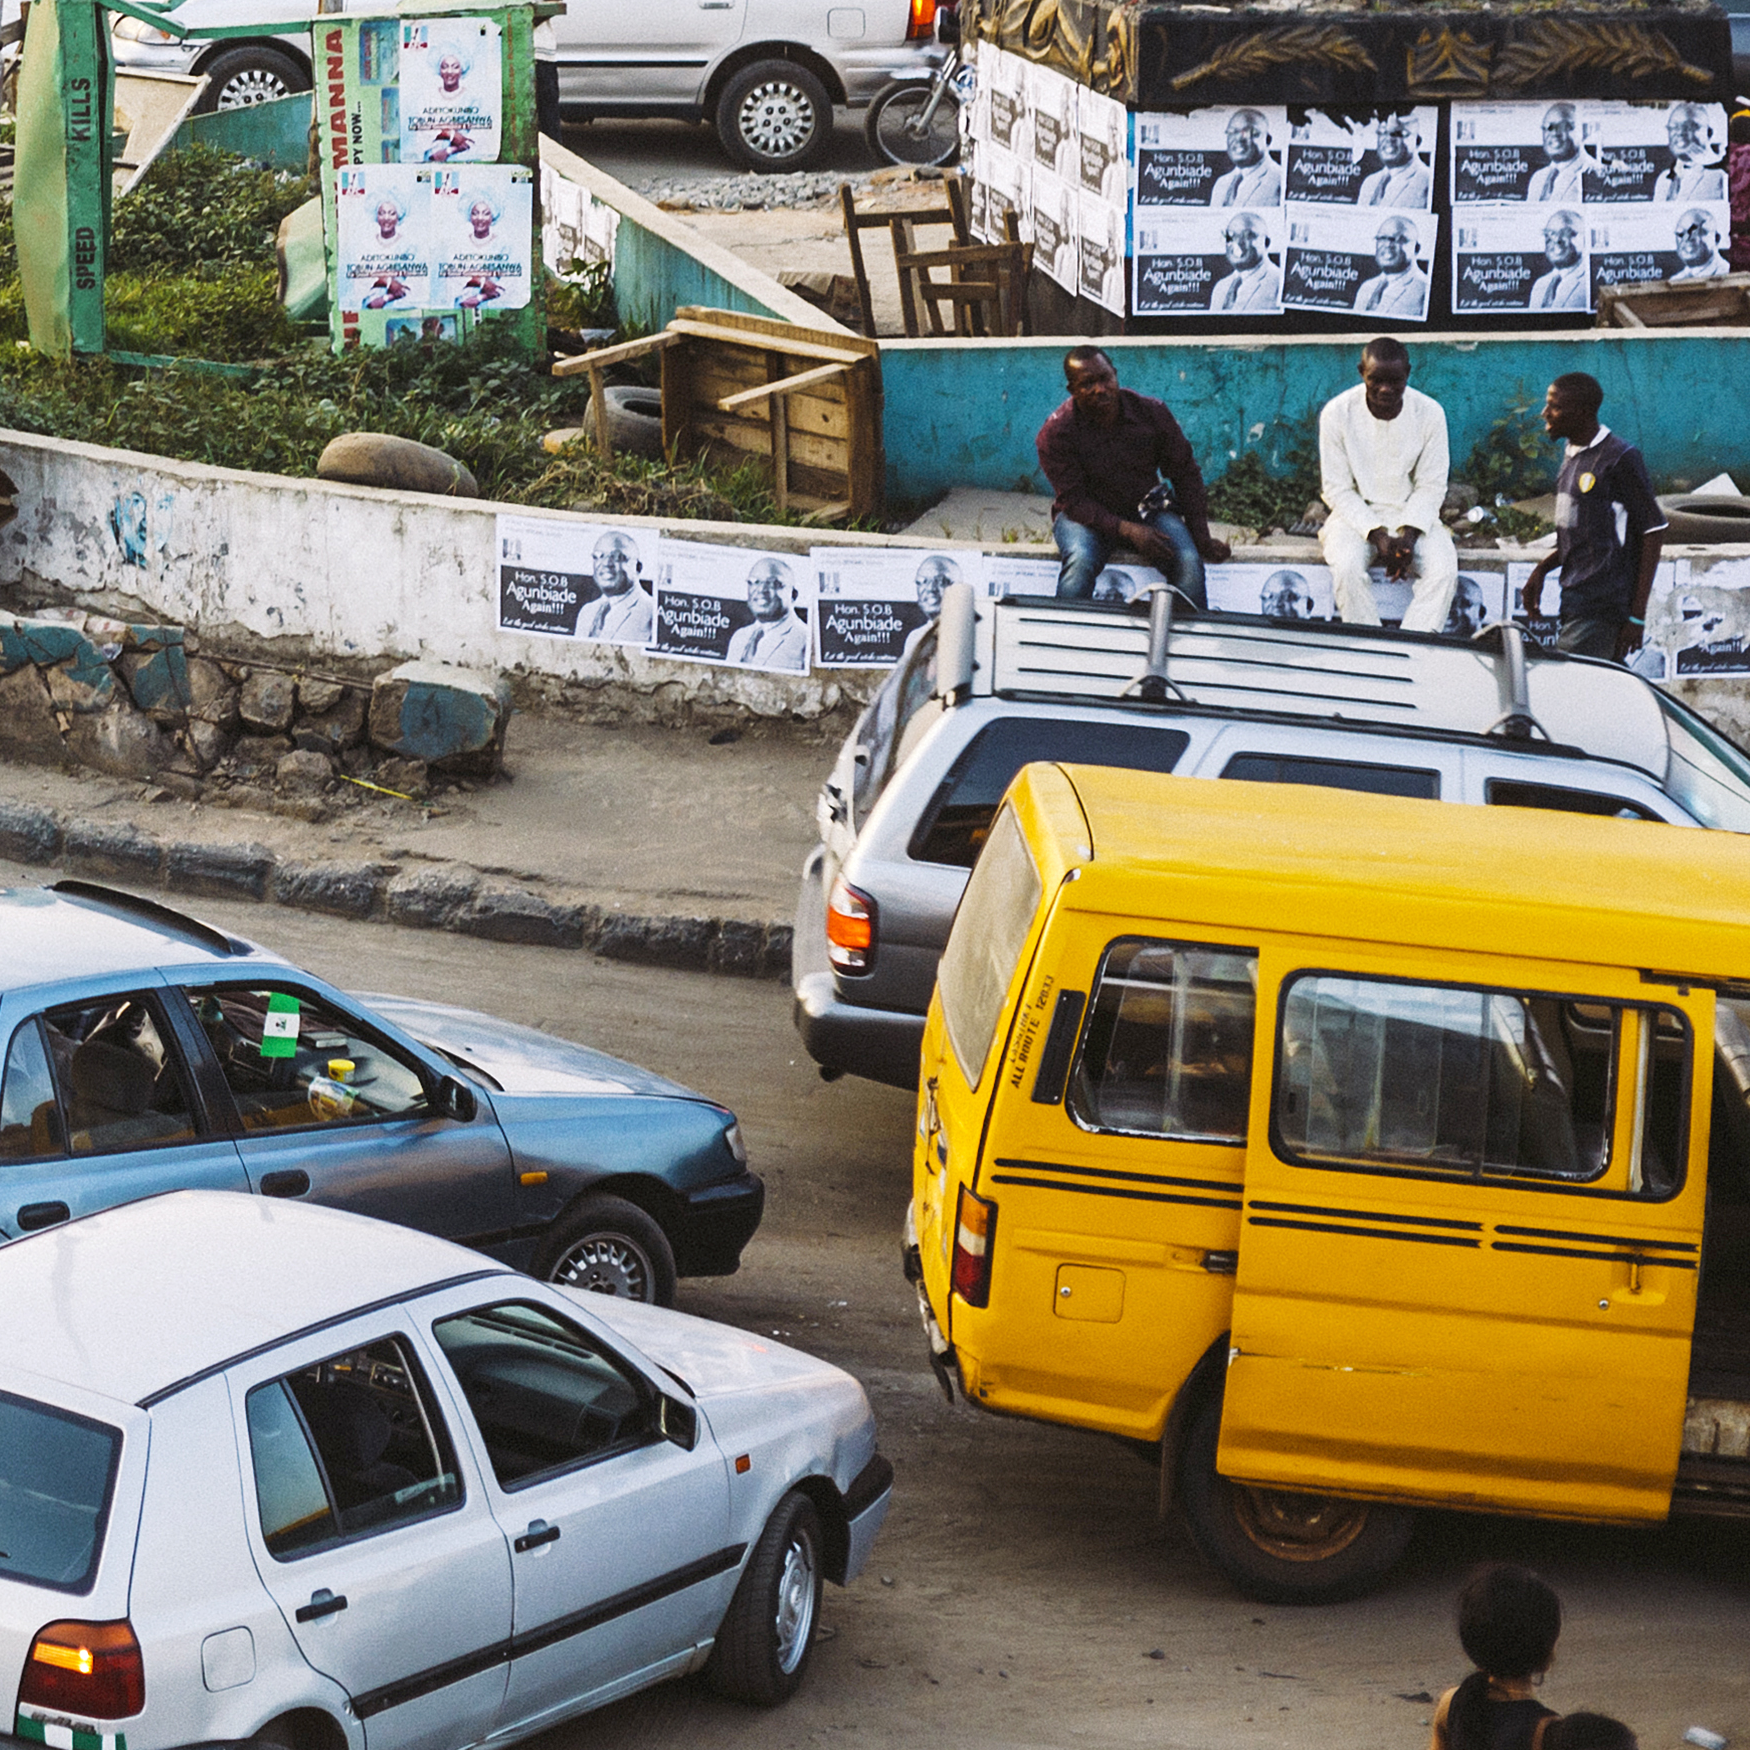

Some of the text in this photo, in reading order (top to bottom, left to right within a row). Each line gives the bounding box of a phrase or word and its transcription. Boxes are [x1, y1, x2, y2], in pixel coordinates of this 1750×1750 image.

[325, 28, 350, 169] MANNA
[1144, 162, 1213, 180] Agunbiade
[1292, 159, 1362, 178] Agunbiade
[1460, 158, 1529, 176] Agunbiade
[70, 76, 98, 290] SPEED KILLS
[1143, 267, 1212, 285] Agunbiade
[1290, 261, 1359, 282] Agunbiade
[1462, 266, 1532, 284] Agunbiade
[1595, 265, 1663, 282] Agunbiade
[514, 571, 537, 586] Hon.
[506, 580, 578, 604] Agunbiade
[663, 595, 689, 609] Hon.
[834, 603, 859, 616] Hon.
[657, 604, 731, 629] Agunbiade
[825, 615, 904, 635] Agunbiade
[1010, 1066, 1026, 1089] ALL
[1018, 1019, 1040, 1063] ROUTE
